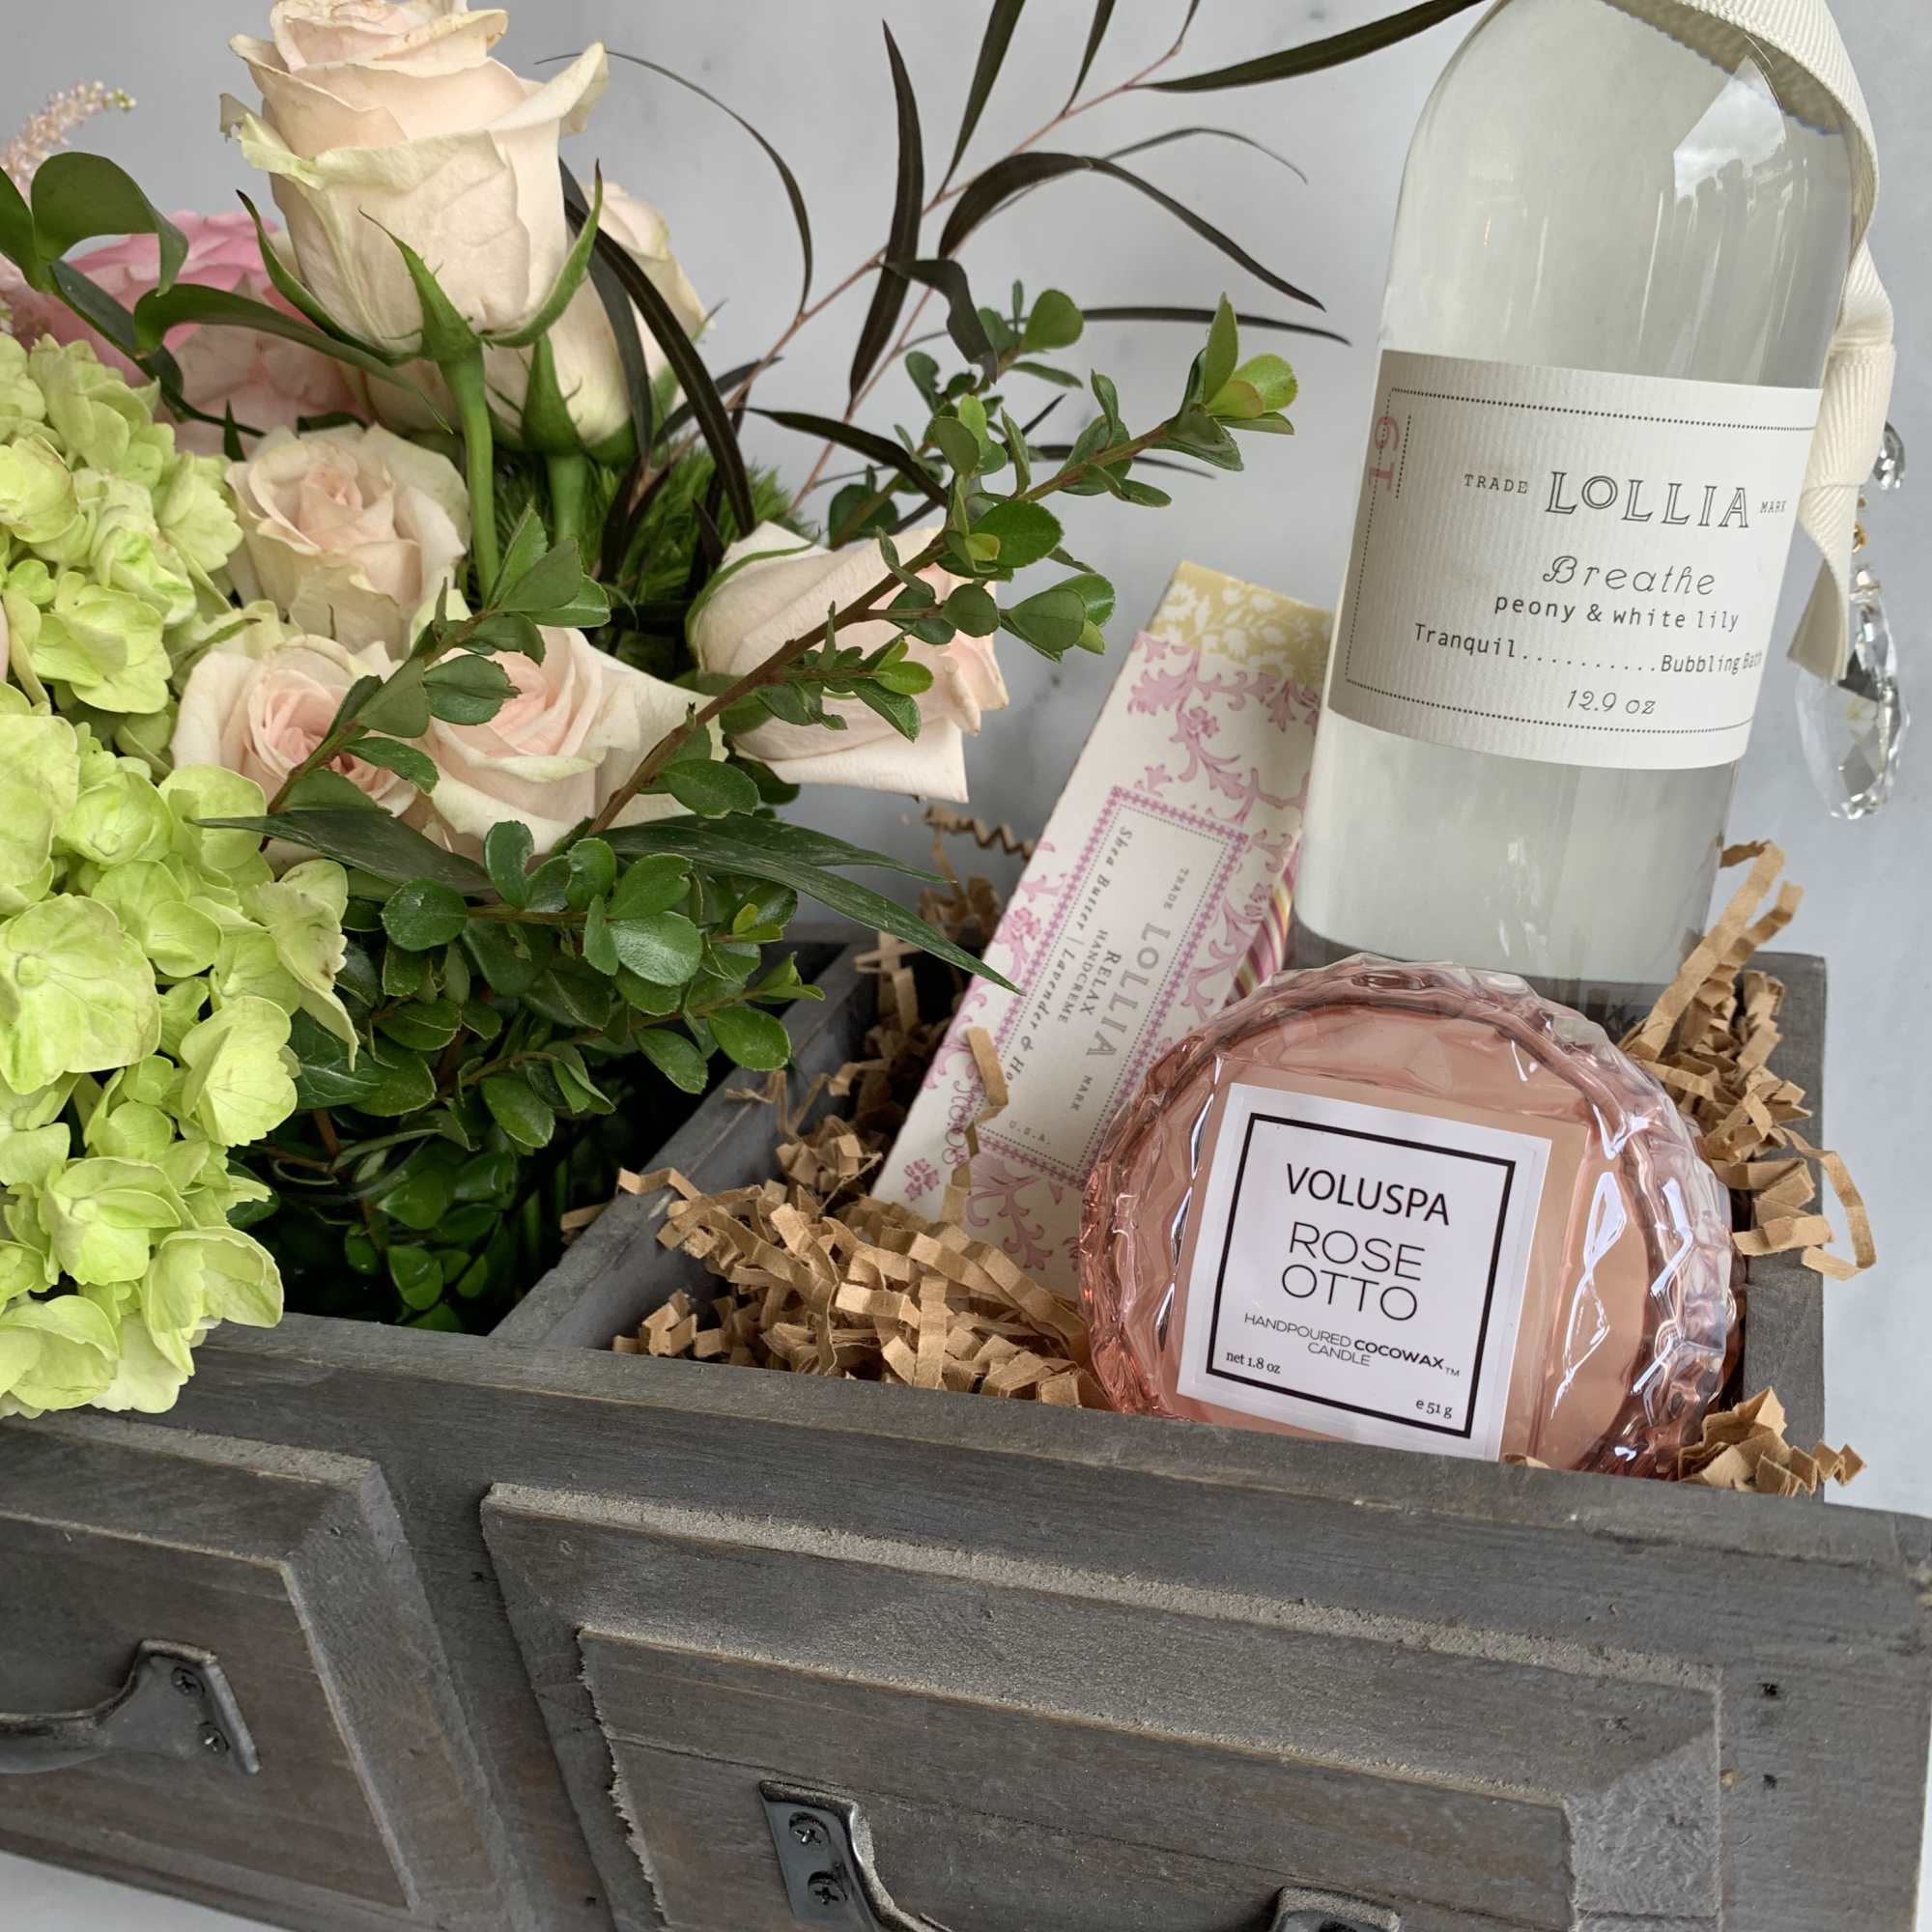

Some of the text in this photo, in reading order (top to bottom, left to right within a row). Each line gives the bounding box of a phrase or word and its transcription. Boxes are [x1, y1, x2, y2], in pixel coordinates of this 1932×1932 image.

[1463, 473, 1528, 494] TRADE
[1545, 470, 1750, 528] LOLLIA
[1543, 555, 1716, 595] Breathe
[1494, 595, 1739, 633] peony & white lily
[1567, 690, 1656, 715] 12.9 oz
[1106, 826, 1132, 867] Shea
[1076, 873, 1111, 930] Butter
[1030, 949, 1075, 1030] Lavender
[1058, 929, 1109, 1024] HANDCREME
[1070, 867, 1189, 1112] TRADE LOLLIA MARK
[1080, 950, 1122, 1015] RELAX
[1021, 1036, 1034, 1051] &
[1286, 1162, 1449, 1226] VOLUSPA
[1289, 1221, 1426, 1281] ROSE
[1282, 1264, 1417, 1321] OTTO
[1244, 1312, 1351, 1348] HANDPOURED
[1307, 1342, 1371, 1367] CANDLE
[1226, 1350, 1281, 1375] net 1.8 oz
[1426, 1403, 1442, 1415] 51
[1443, 1406, 1453, 1419] g
